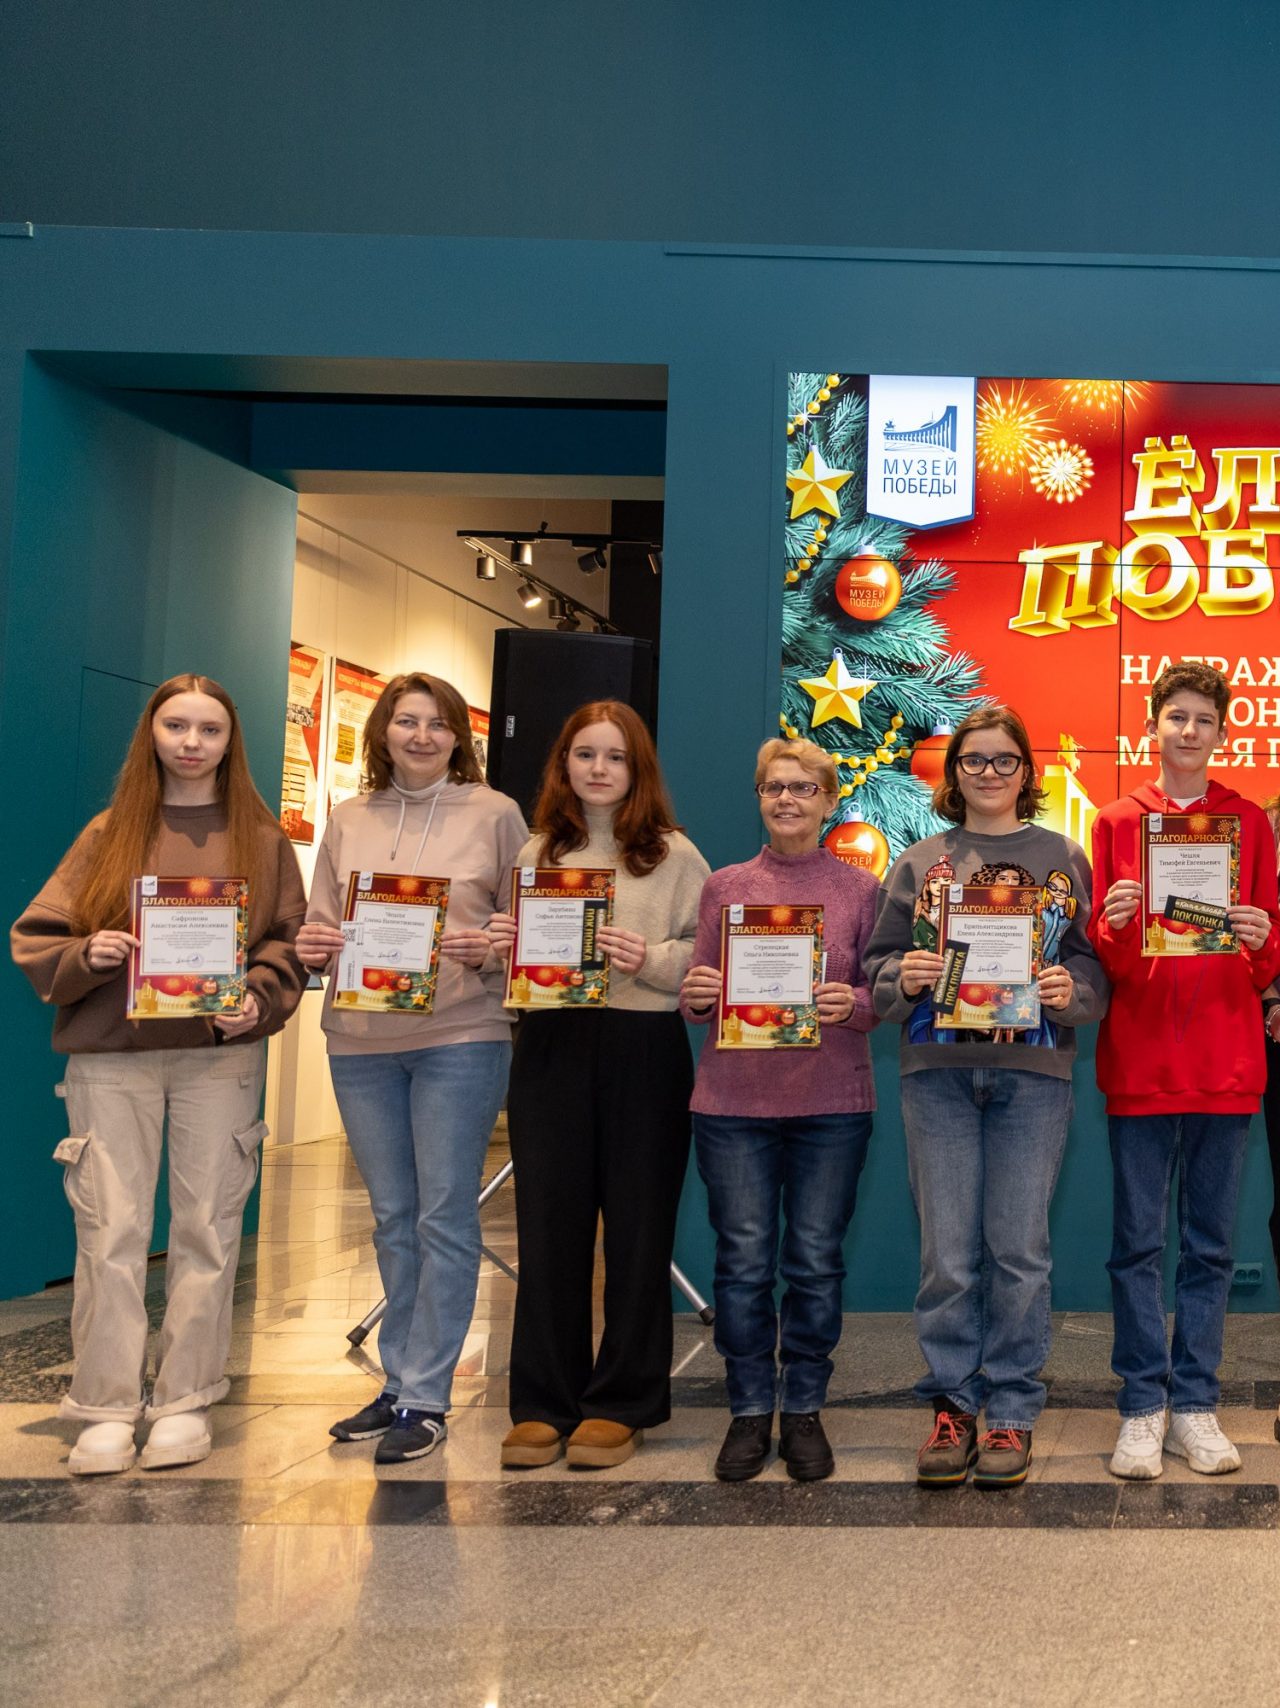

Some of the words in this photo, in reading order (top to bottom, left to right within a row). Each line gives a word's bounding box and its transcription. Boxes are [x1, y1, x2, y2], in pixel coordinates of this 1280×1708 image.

[883, 457, 957, 476] МУЗЕЙ
[883, 477, 957, 498] ПОБЕДЫ
[849, 588, 886, 599] МУЗЕЙ
[850, 597, 885, 609] ПОБЕДЫ
[1116, 735, 1256, 768] МЕЯ
[1149, 834, 1231, 843] БЛАГОДАРНОСТЬ
[357, 892, 439, 905] БЛАГОДАРНОСТЬ
[520, 888, 605, 897] БЛАГОДАРНОСТЬ
[142, 897, 237, 906] БЛАГОДАРНОСТЬ
[949, 905, 1033, 914] БЛАГОДАРНОСТЬ
[1172, 909, 1224, 929] ПОКЛОНКА
[583, 908, 595, 961] ПОКЛОНКА
[729, 925, 814, 934] БЛАГОДАРНОСТЬ
[944, 951, 966, 1006] ПОКЛОНКА
